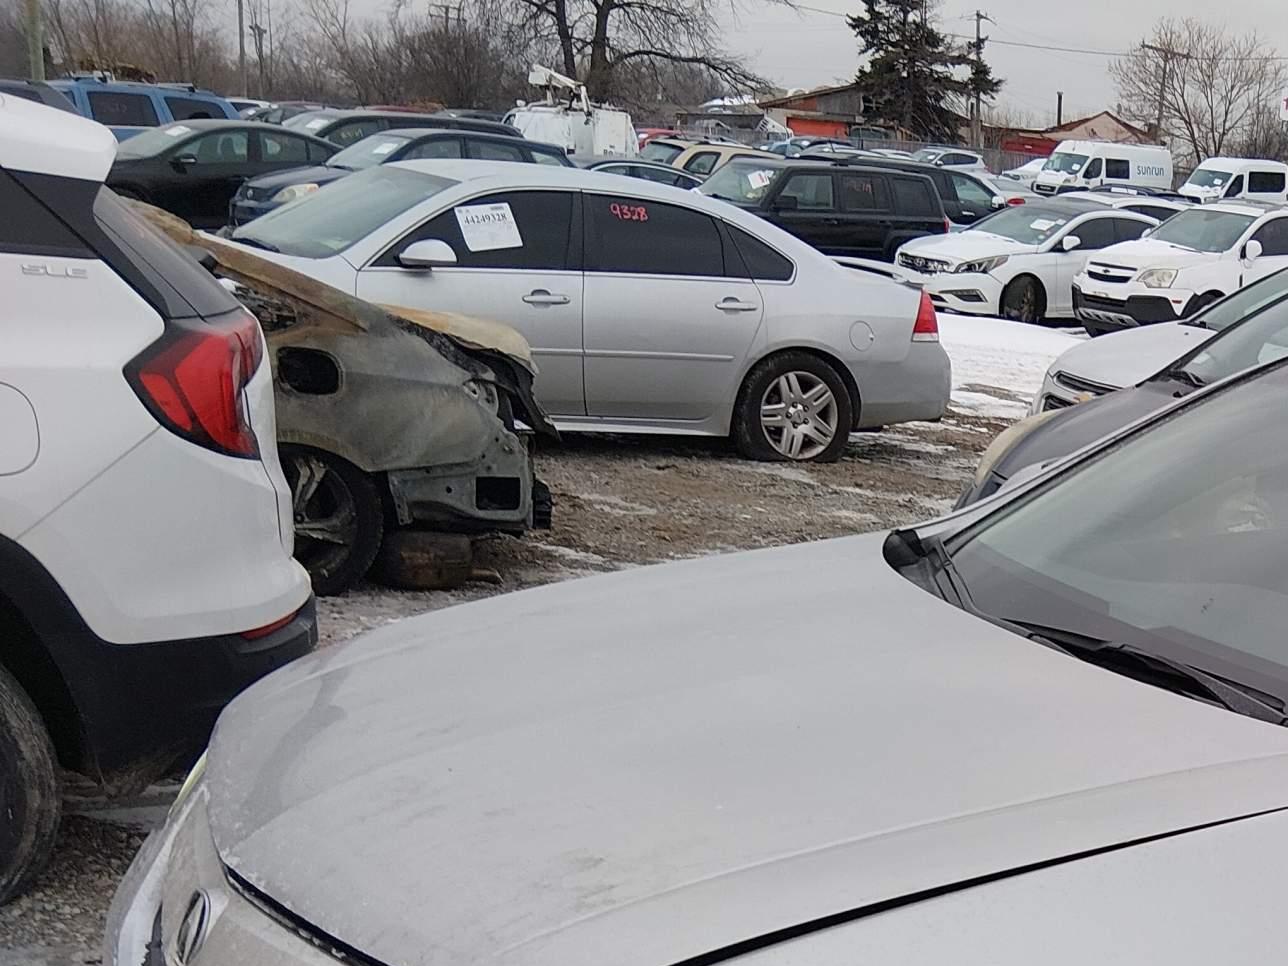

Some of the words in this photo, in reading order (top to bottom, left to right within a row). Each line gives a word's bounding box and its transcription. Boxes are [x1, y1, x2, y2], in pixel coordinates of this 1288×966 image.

[1136, 165, 1165, 176] sunrun
[609, 202, 649, 222] 9328
[21, 263, 88, 279] SLE
